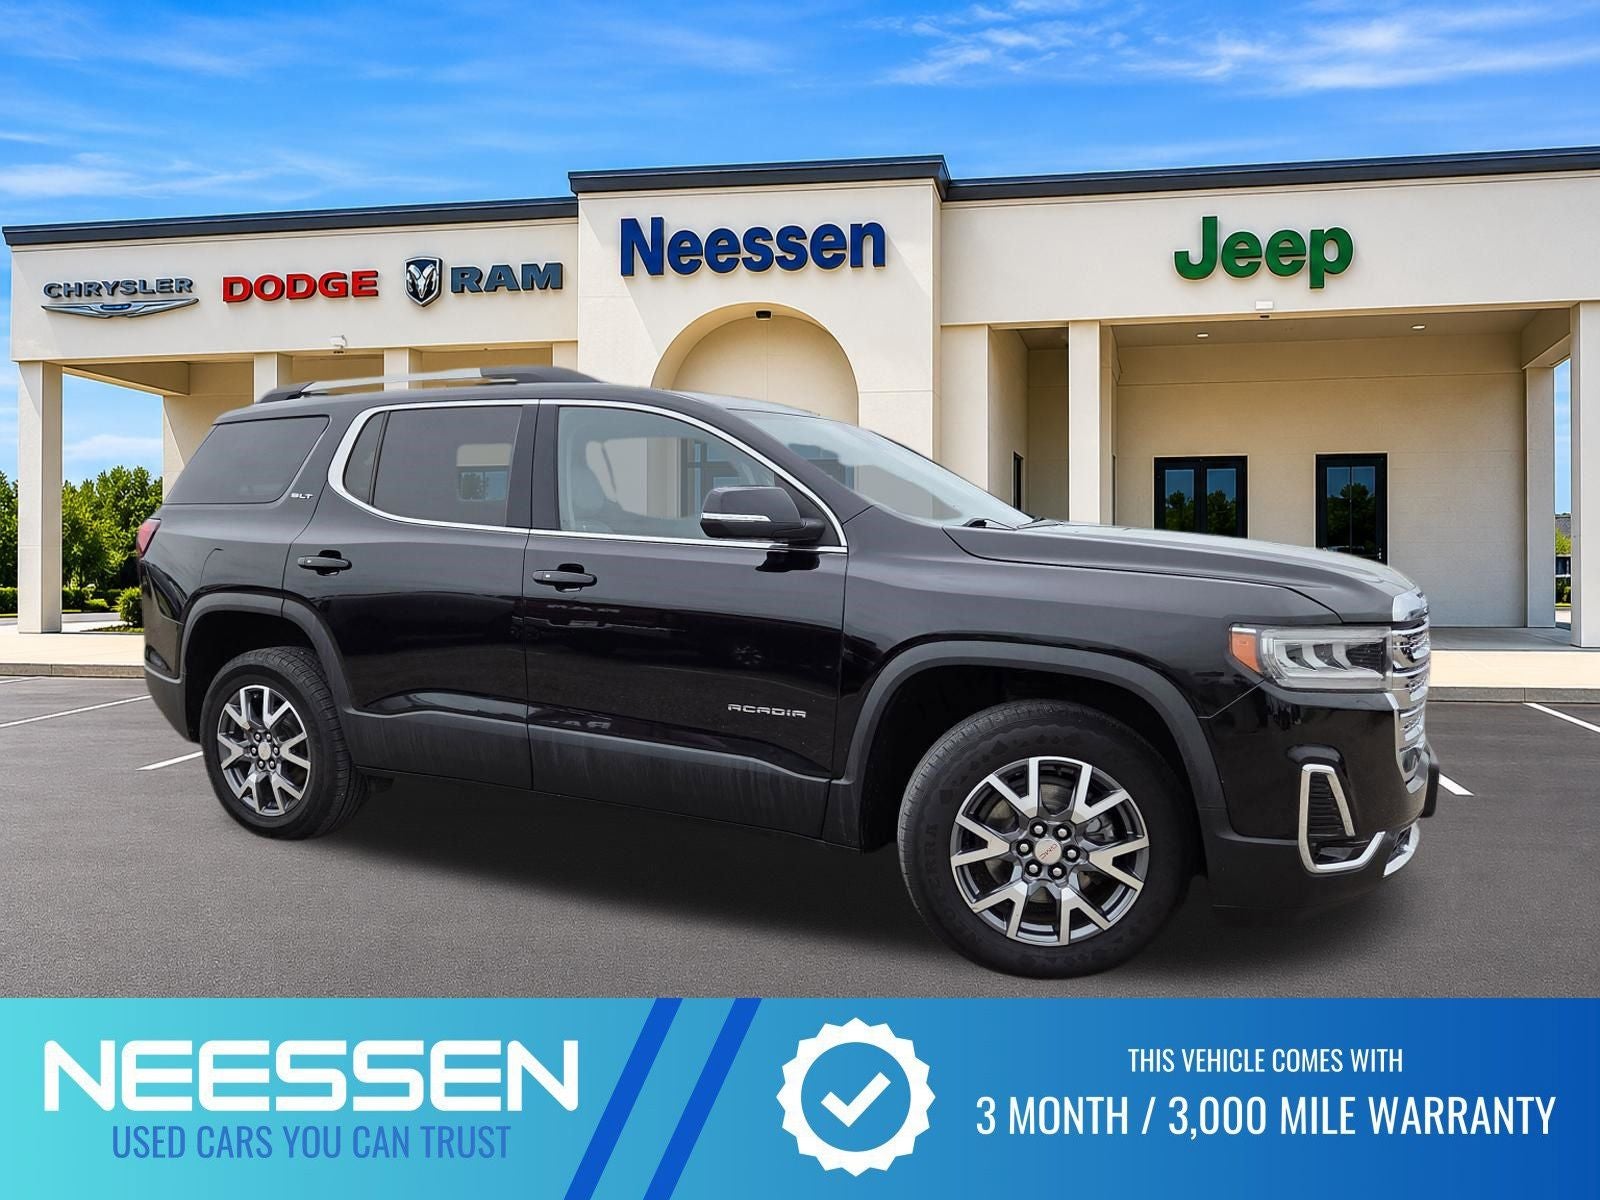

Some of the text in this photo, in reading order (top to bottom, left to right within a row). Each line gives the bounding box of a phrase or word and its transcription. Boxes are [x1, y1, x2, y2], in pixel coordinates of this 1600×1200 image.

[620, 217, 885, 276] Neessen
[1174, 216, 1354, 289] Jeep
[43, 277, 194, 300] CHRYSLER
[222, 270, 379, 303] DODGE
[450, 262, 564, 295] RAM
[727, 703, 807, 719] ACADIA
